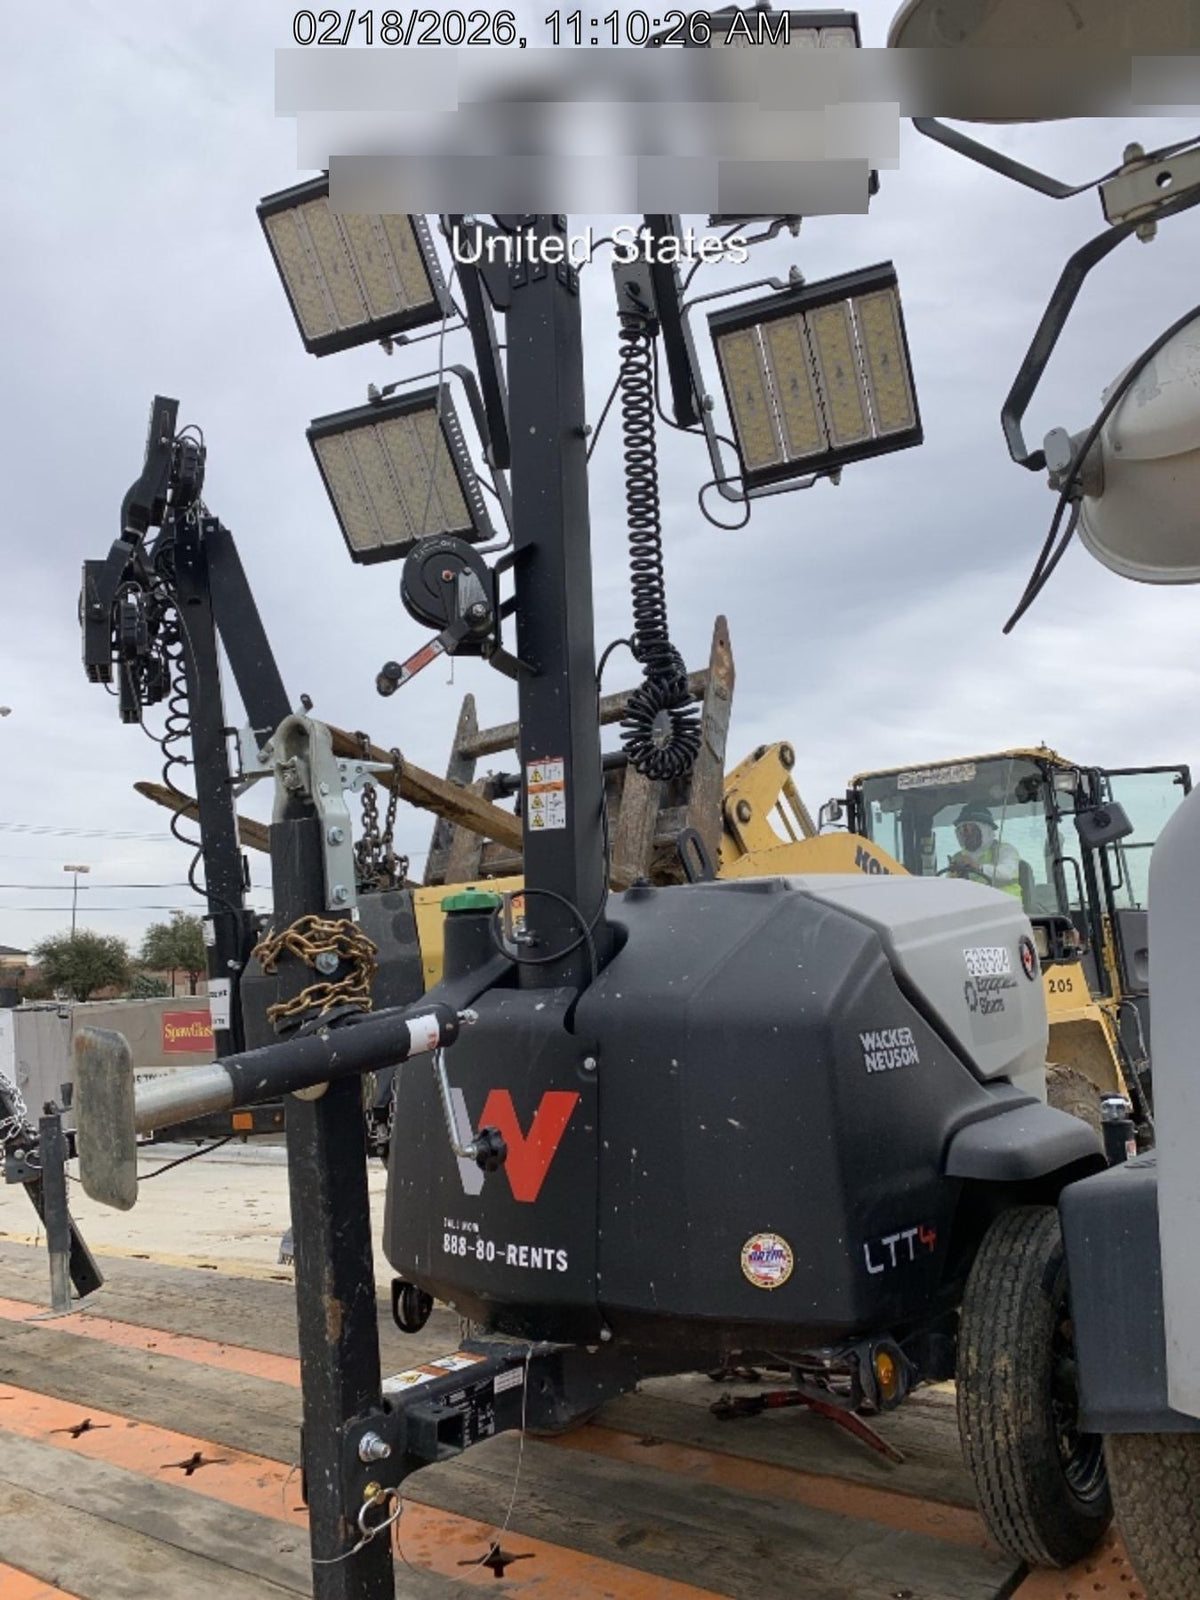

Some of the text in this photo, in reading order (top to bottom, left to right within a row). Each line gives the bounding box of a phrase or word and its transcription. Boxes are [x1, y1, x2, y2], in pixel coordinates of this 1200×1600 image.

[1048, 977, 1073, 993] 205
[859, 1026, 915, 1051] WACKER
[864, 1045, 920, 1073] NEUSON
[443, 1232, 568, 1272] 888-80-RENTS
